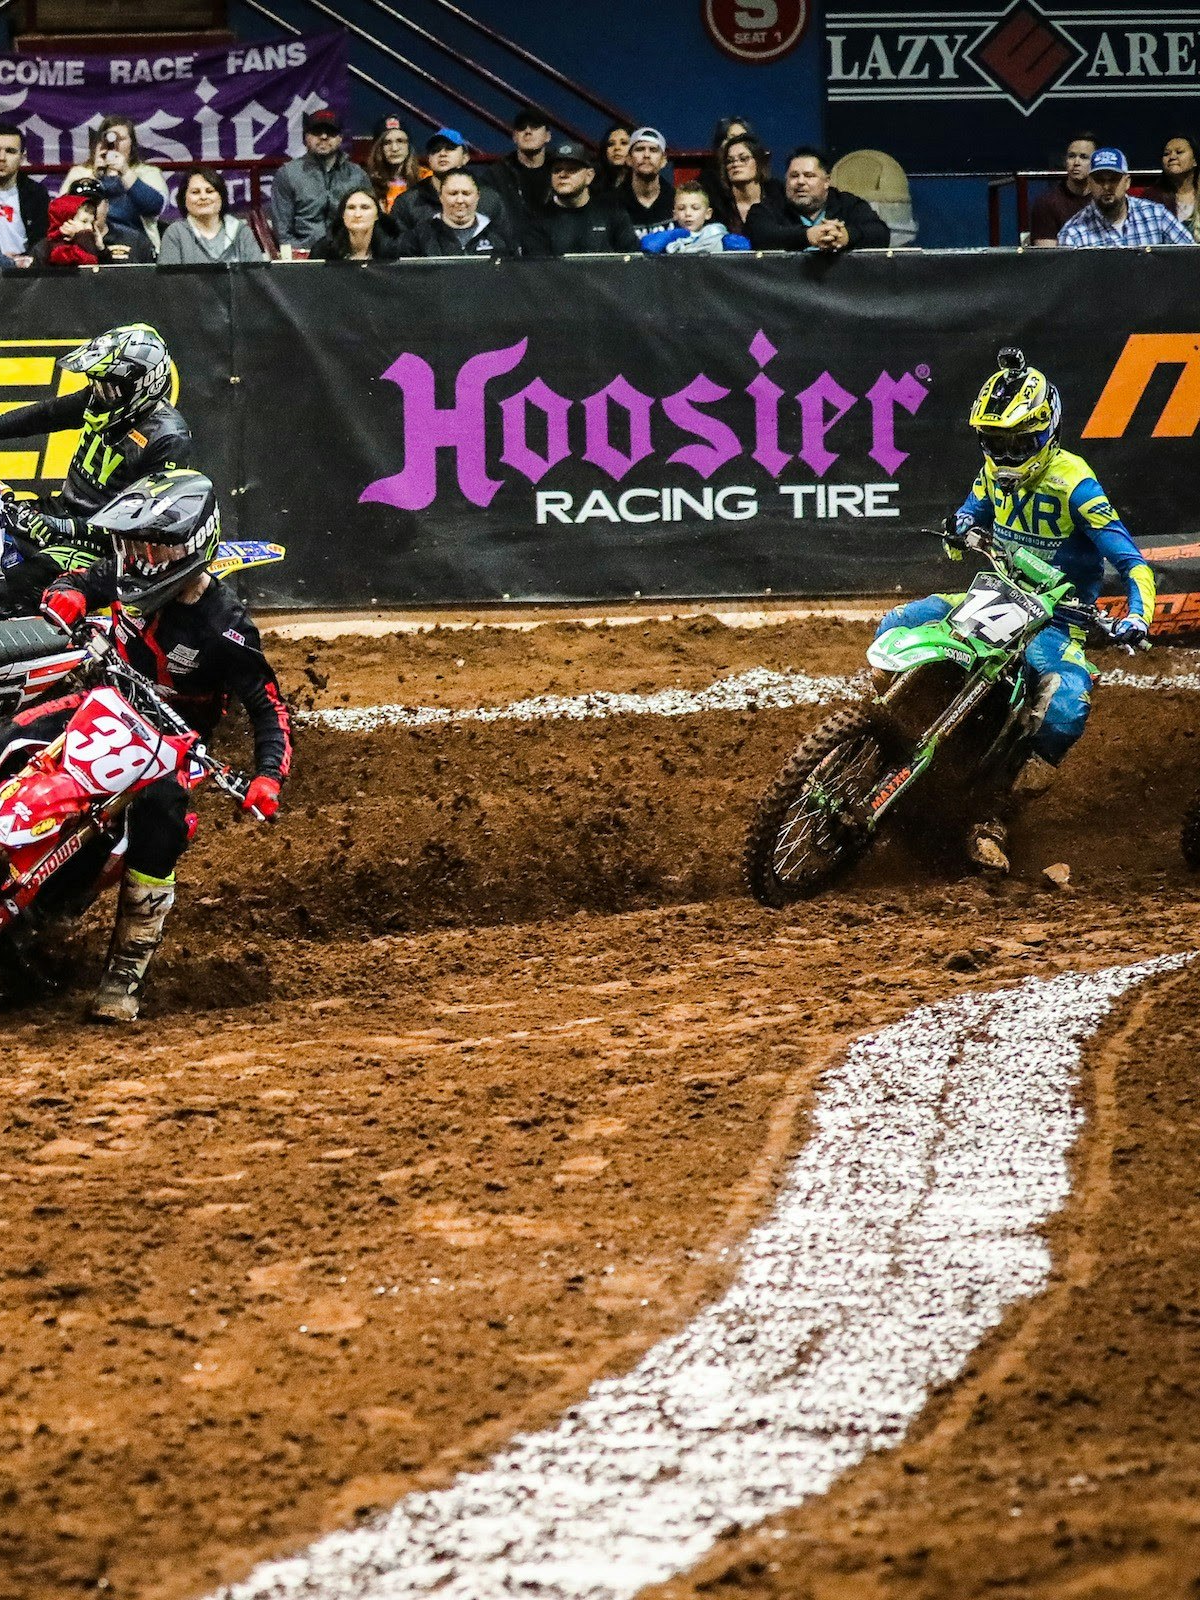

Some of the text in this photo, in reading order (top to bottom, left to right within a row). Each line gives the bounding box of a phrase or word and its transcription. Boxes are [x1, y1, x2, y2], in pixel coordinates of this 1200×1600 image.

[734, 32, 767, 45] SEAT
[826, 35, 968, 80] LAZY
[1087, 32, 1200, 77] ARE
[109, 56, 194, 85] RACE
[226, 42, 307, 75] FANS
[358, 328, 930, 512] Hoosier
[535, 483, 900, 526] RACING TIRE
[952, 588, 1034, 644] 14
[67, 715, 160, 793] 38
